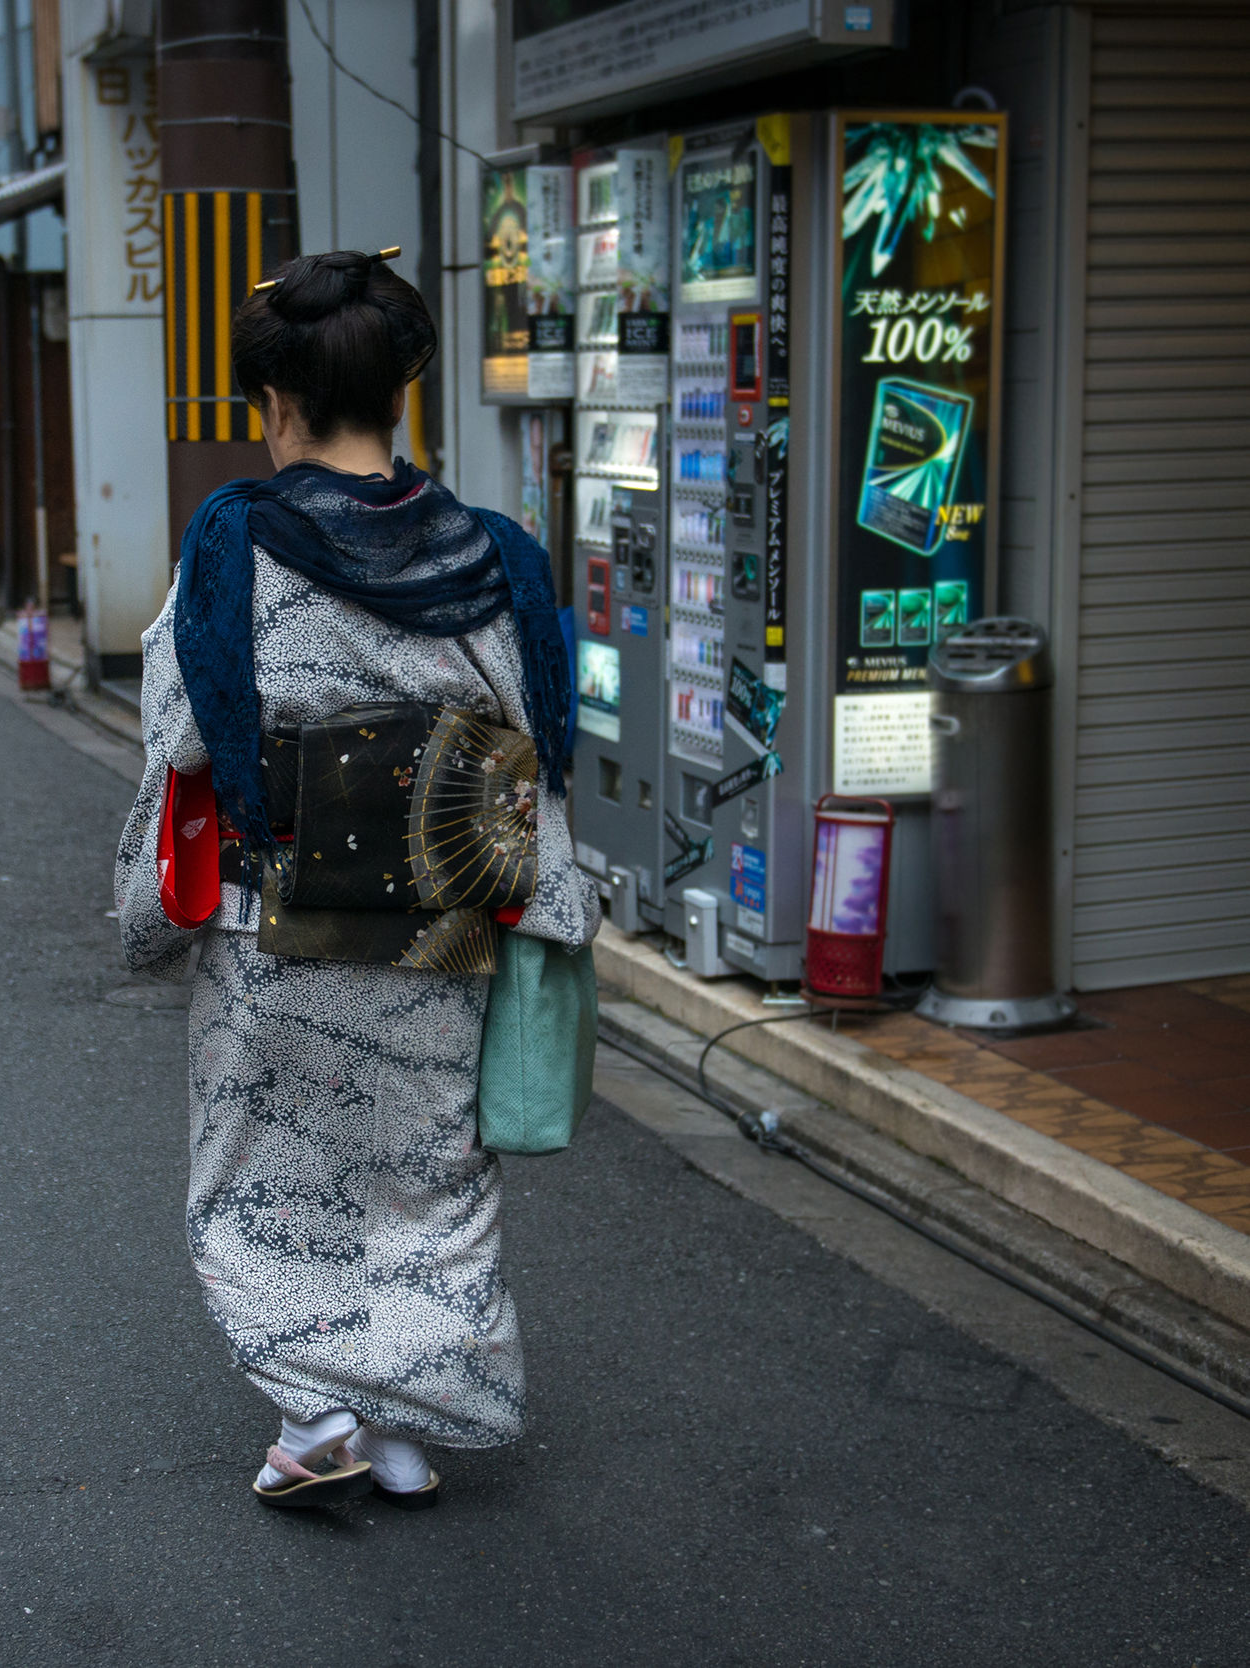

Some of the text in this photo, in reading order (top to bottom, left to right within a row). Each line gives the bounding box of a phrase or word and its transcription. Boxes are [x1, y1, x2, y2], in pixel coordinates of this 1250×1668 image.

[123, 114, 161, 303] バッカスビル
[850, 289, 990, 316] 天然メンソール
[626, 328, 657, 339] ICE
[861, 317, 974, 363] 100%
[881, 417, 926, 442] MEVIUS
[935, 504, 986, 526] NEW
[864, 655, 908, 668] MEVIUS
[846, 669, 900, 683] PREMIUM
